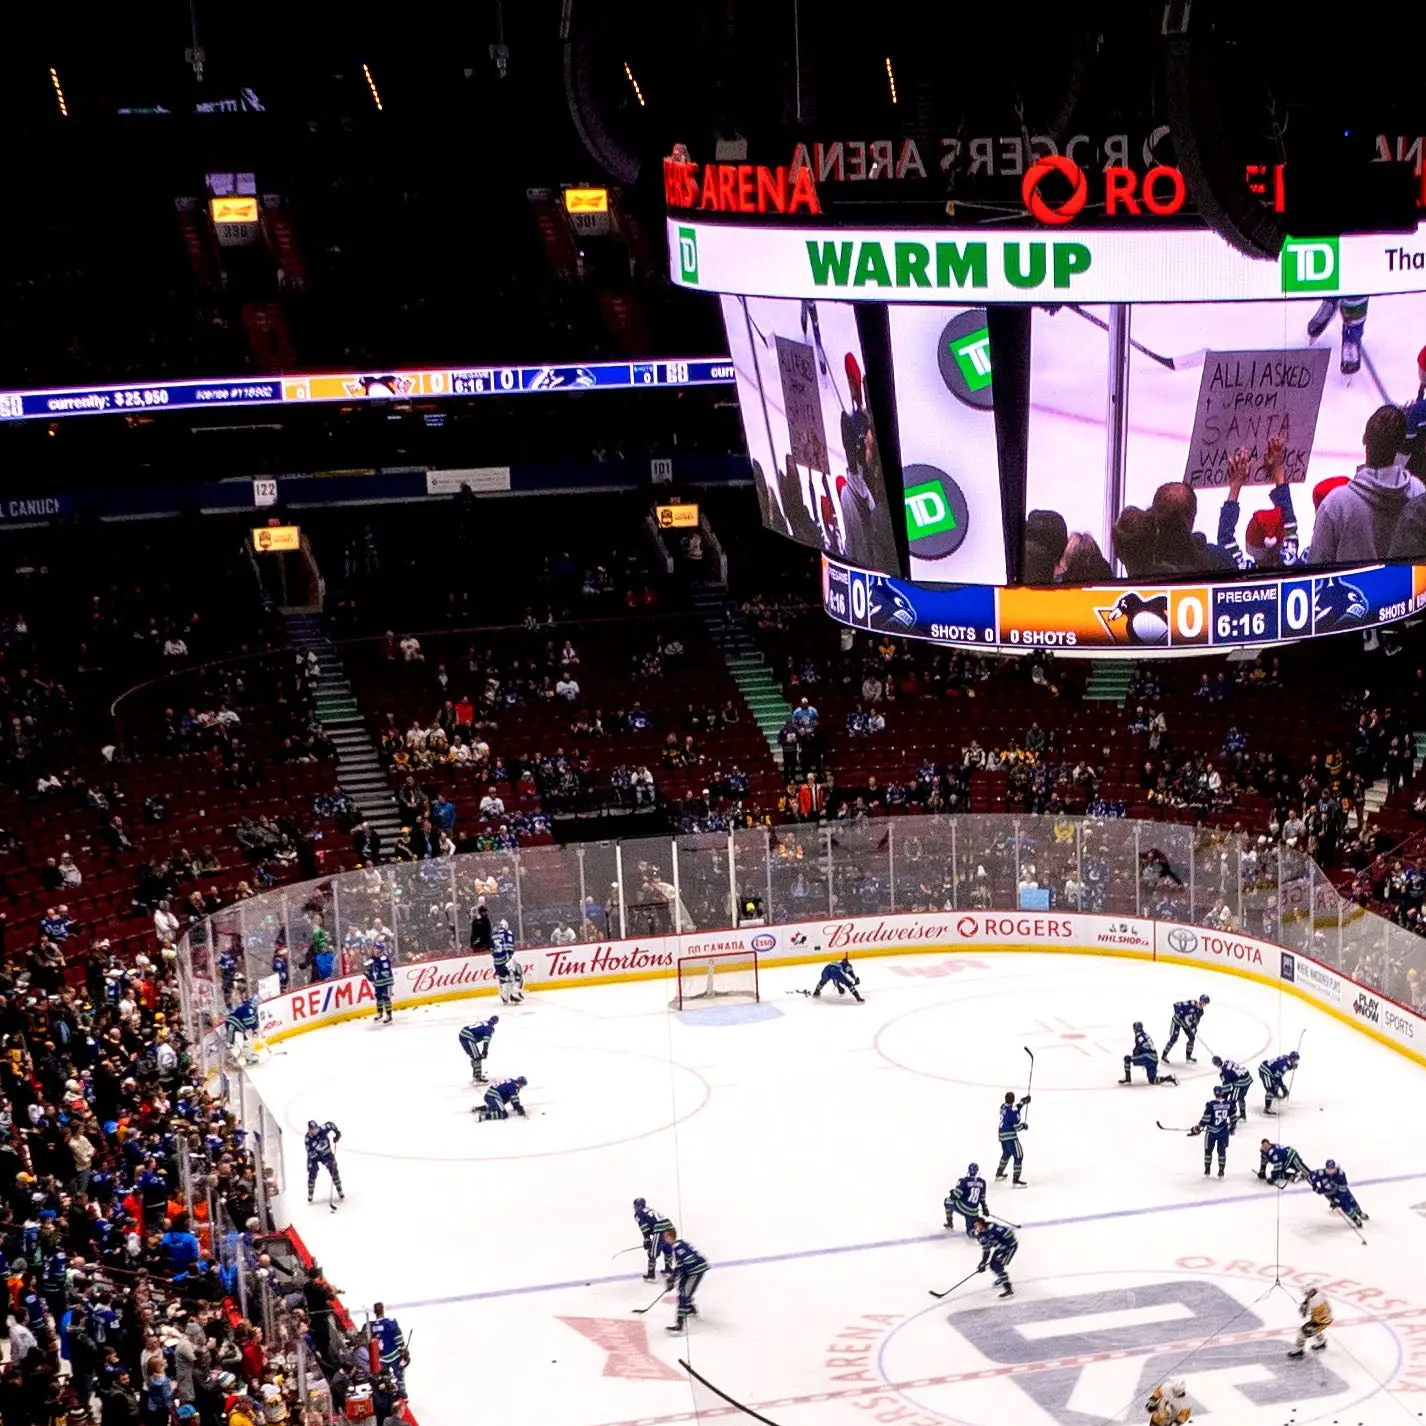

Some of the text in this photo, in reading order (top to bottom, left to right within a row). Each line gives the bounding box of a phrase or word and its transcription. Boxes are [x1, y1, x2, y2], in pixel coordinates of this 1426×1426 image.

[701, 163, 823, 214] ARENA
[805, 240, 1093, 289] WARM UP
[1286, 244, 1335, 282] TD
[430, 371, 444, 393] 0
[501, 370, 514, 389] 0
[1210, 360, 1243, 390] ALL
[1260, 363, 1312, 389] ASKED
[1234, 392, 1278, 410] FROM
[1202, 413, 1290, 446] SANTA
[256, 480, 276, 496] 122
[1177, 588, 1309, 638] 0 PREGAME 0
[1217, 613, 1266, 637] 6:16
[1378, 603, 1406, 622] SHOTS
[930, 624, 994, 643] SHOTS 0
[1010, 629, 1077, 645] 0 SHOTS
[823, 921, 949, 949] Budweiser
[985, 919, 1073, 938] ROGERS
[545, 945, 674, 977] Tim Hortons
[1200, 935, 1263, 966] TOYOTA
[291, 979, 376, 1022] RE/MA
[1358, 1002, 1379, 1024] NOW
[1359, 991, 1379, 1010] PLAY
[1384, 1008, 1414, 1038] SPORTS
[825, 1311, 905, 1383] ARENA
